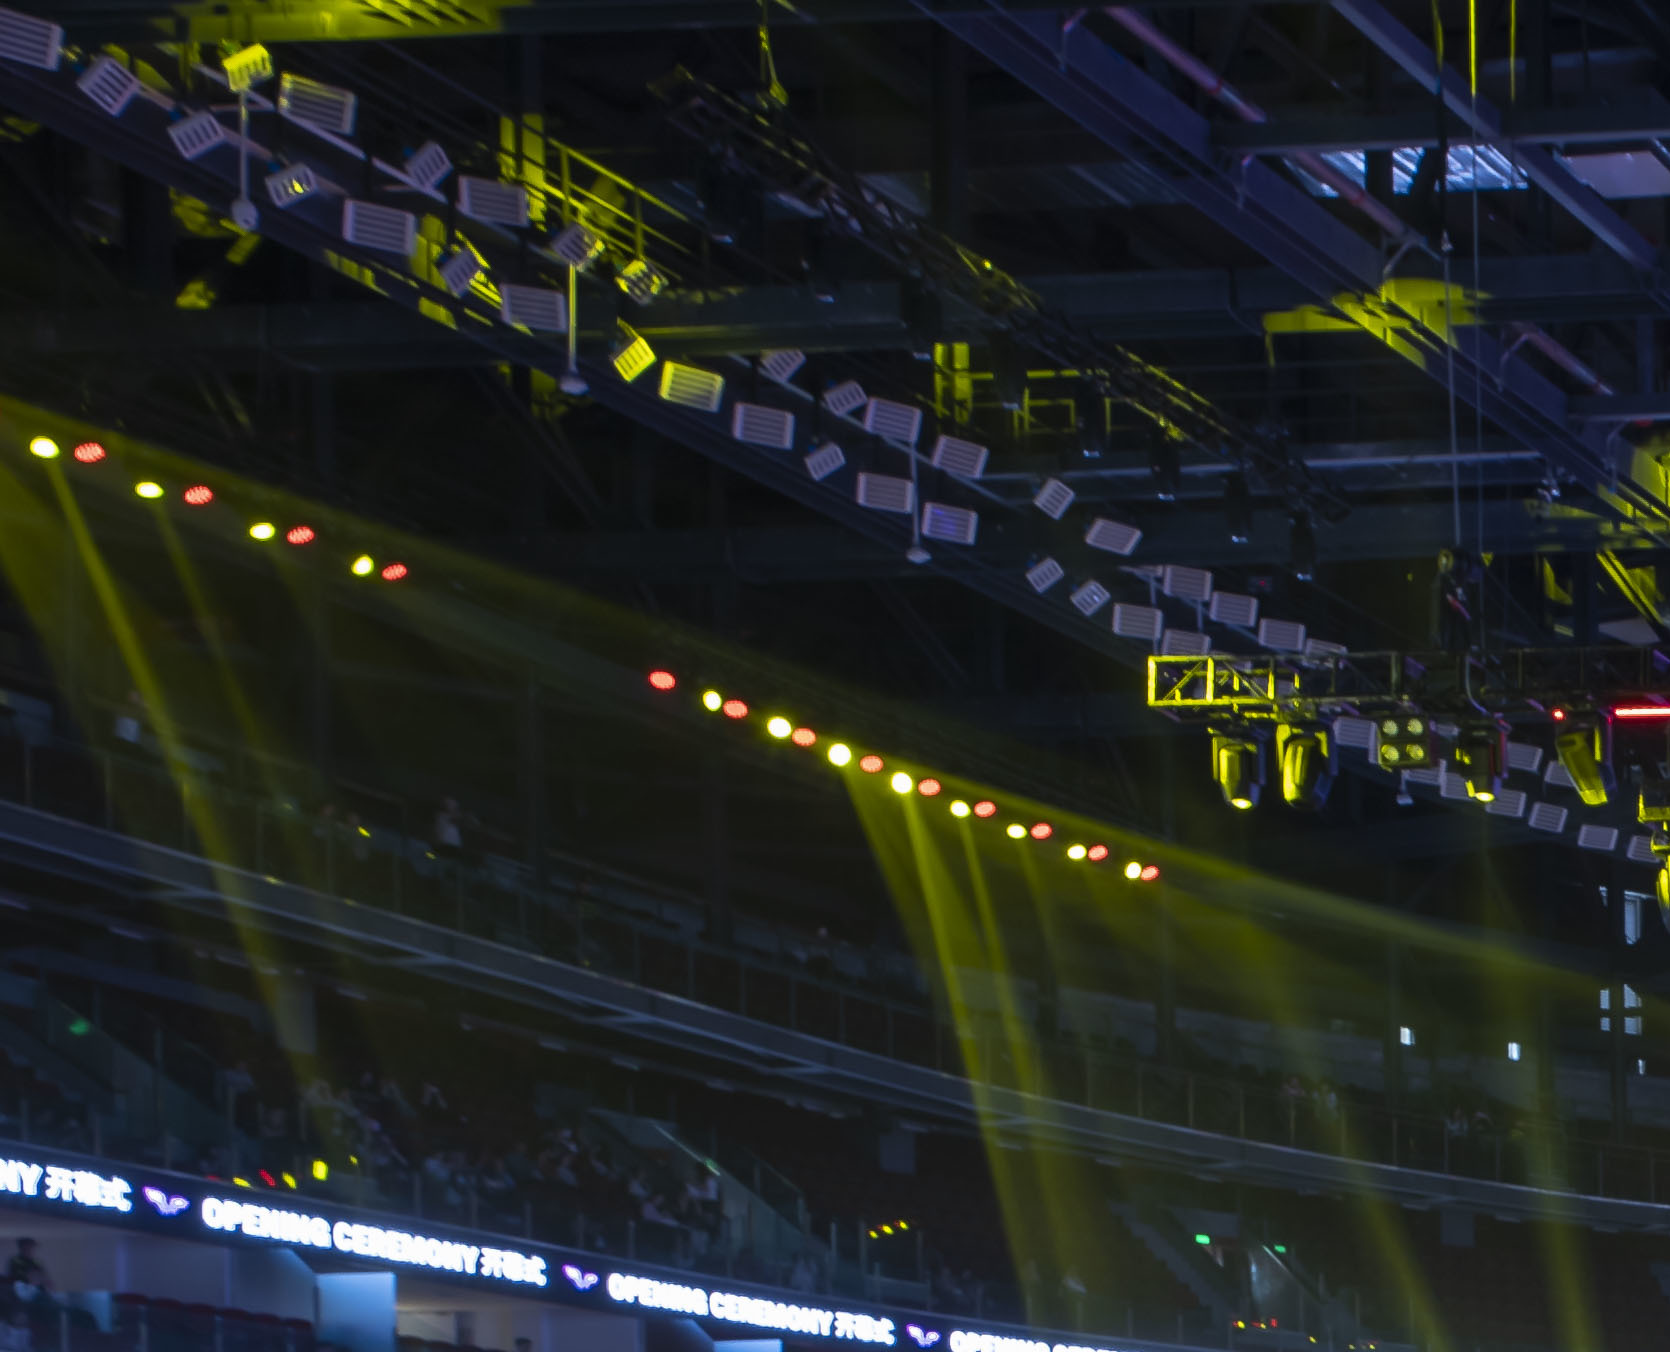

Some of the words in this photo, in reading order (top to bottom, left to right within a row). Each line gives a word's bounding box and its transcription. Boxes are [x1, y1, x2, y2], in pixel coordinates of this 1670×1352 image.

[201, 1197, 332, 1247] OPENING
[332, 1221, 480, 1274] CEREMONY
[607, 1272, 709, 1316] OPENING
[709, 1291, 835, 1336] CEREMONY
